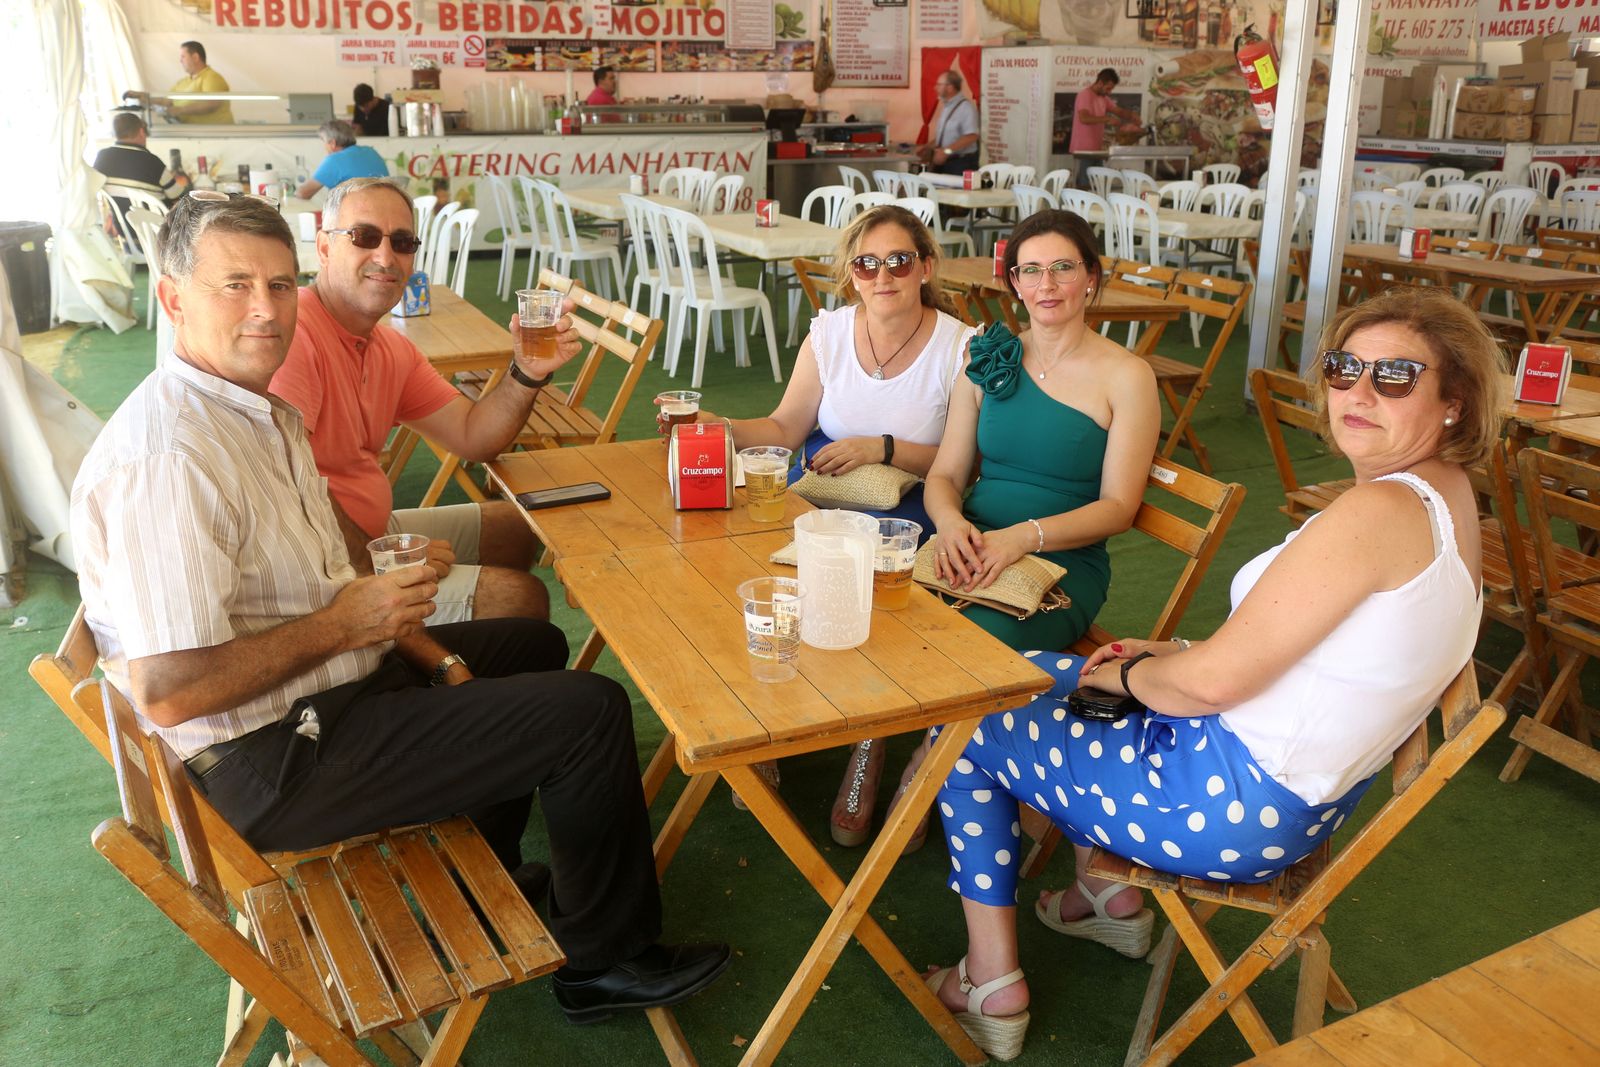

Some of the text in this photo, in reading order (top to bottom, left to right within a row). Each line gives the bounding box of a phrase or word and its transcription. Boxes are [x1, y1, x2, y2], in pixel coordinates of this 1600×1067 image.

[214, 0, 424, 36] REBUJITOS,
[1411, 19, 1436, 39] 605
[1437, 19, 1465, 39] 275
[1488, 19, 1535, 37] MACETA
[1055, 56, 1145, 66] CATERING MANHATTAN
[408, 151, 754, 178] CATERING MANHATTAN
[682, 466, 723, 476] Cruzcampo
